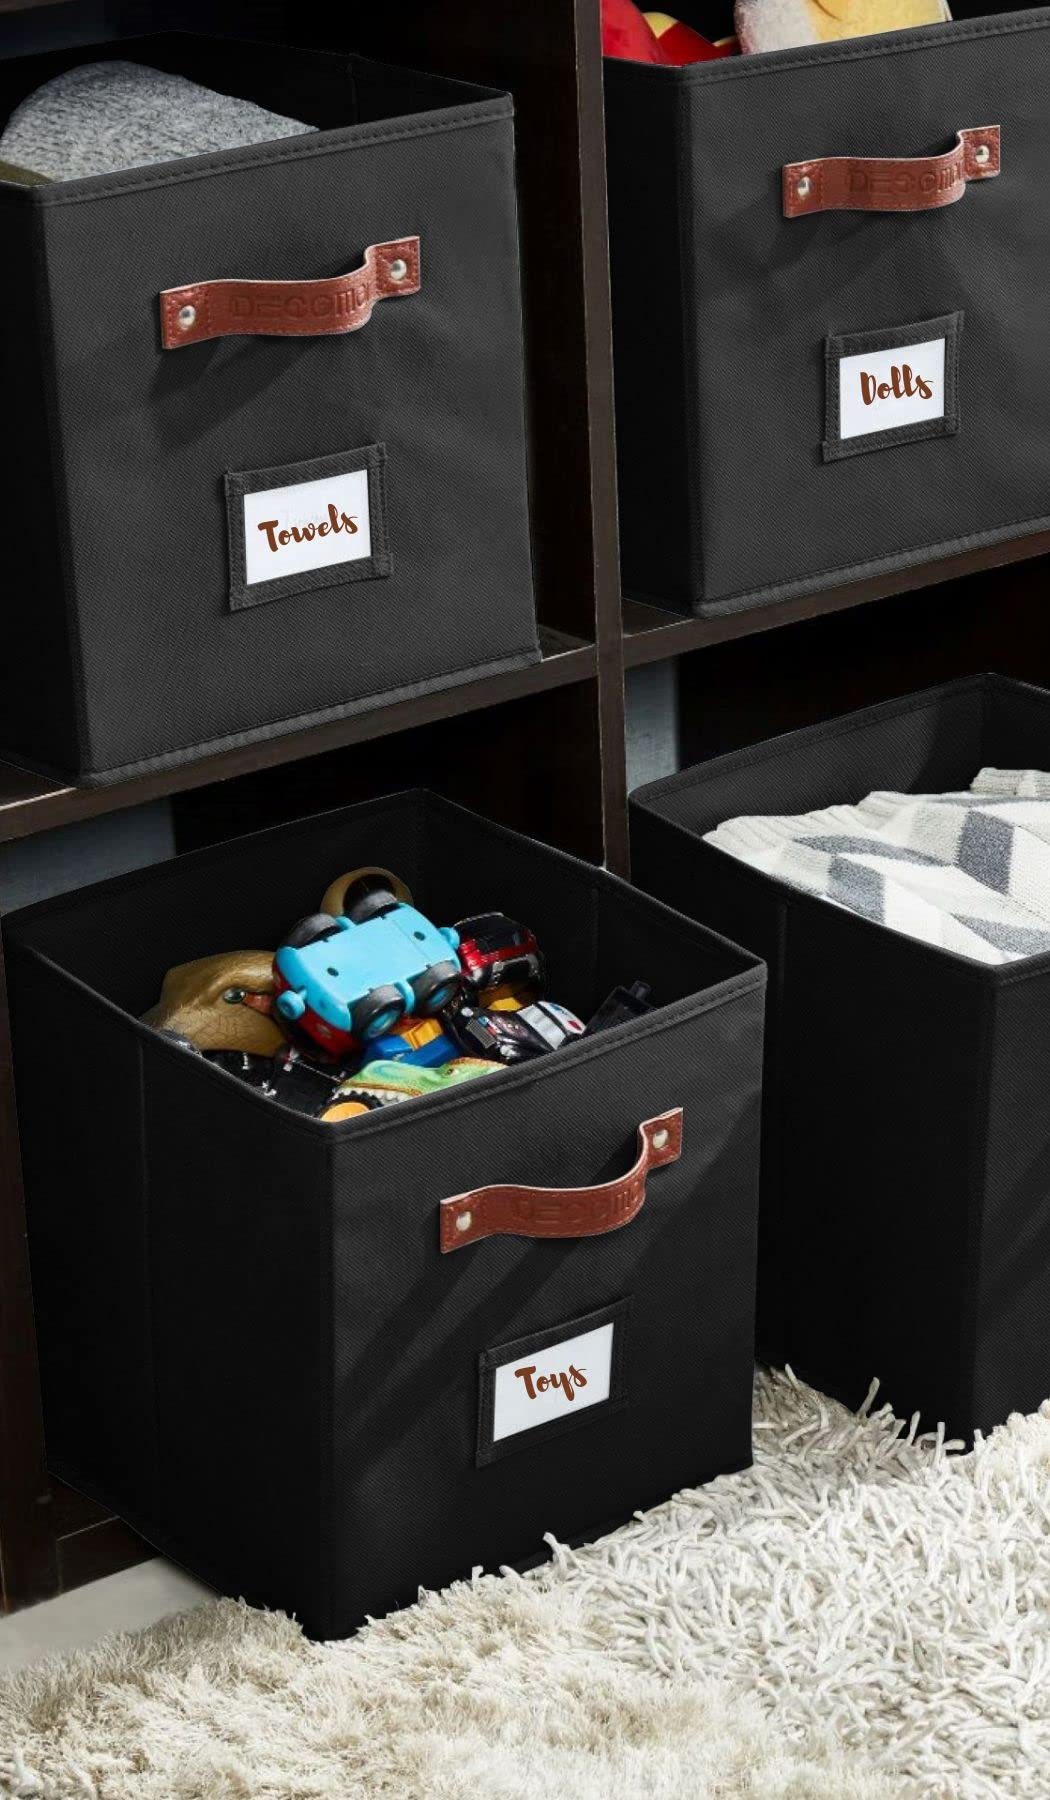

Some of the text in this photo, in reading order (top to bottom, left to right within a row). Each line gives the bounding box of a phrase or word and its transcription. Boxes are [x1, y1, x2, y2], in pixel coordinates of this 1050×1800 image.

[860, 364, 934, 405] Dolls
[257, 503, 358, 552] Towels
[514, 1365, 588, 1401] Toys
